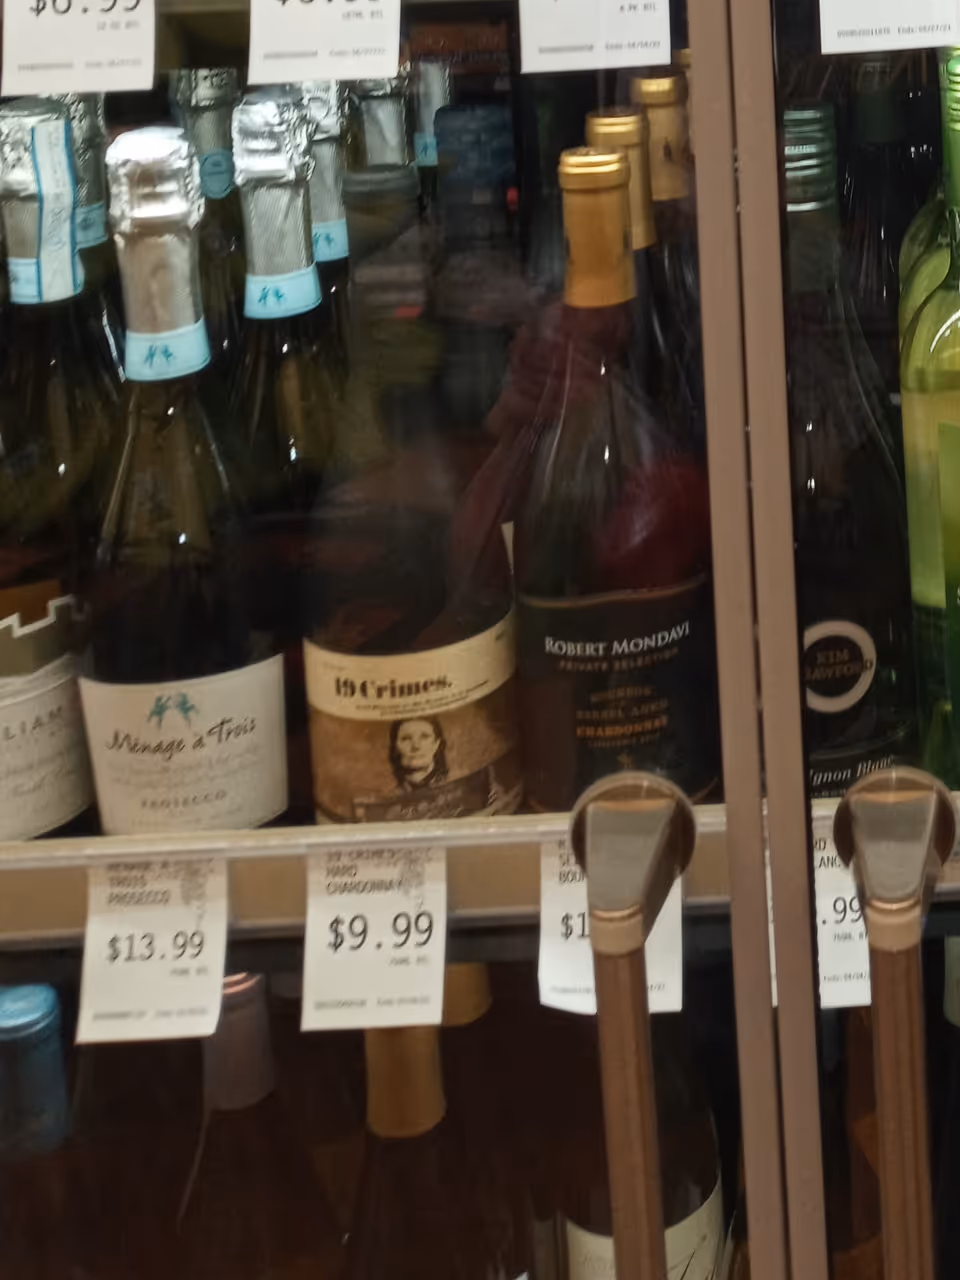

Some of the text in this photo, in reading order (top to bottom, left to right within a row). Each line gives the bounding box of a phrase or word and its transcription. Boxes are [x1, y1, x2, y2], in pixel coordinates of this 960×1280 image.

[545, 621, 690, 657] ROBERT MONDAVI
[106, 929, 205, 963] $13.99
[328, 910, 433, 952] $9.99
